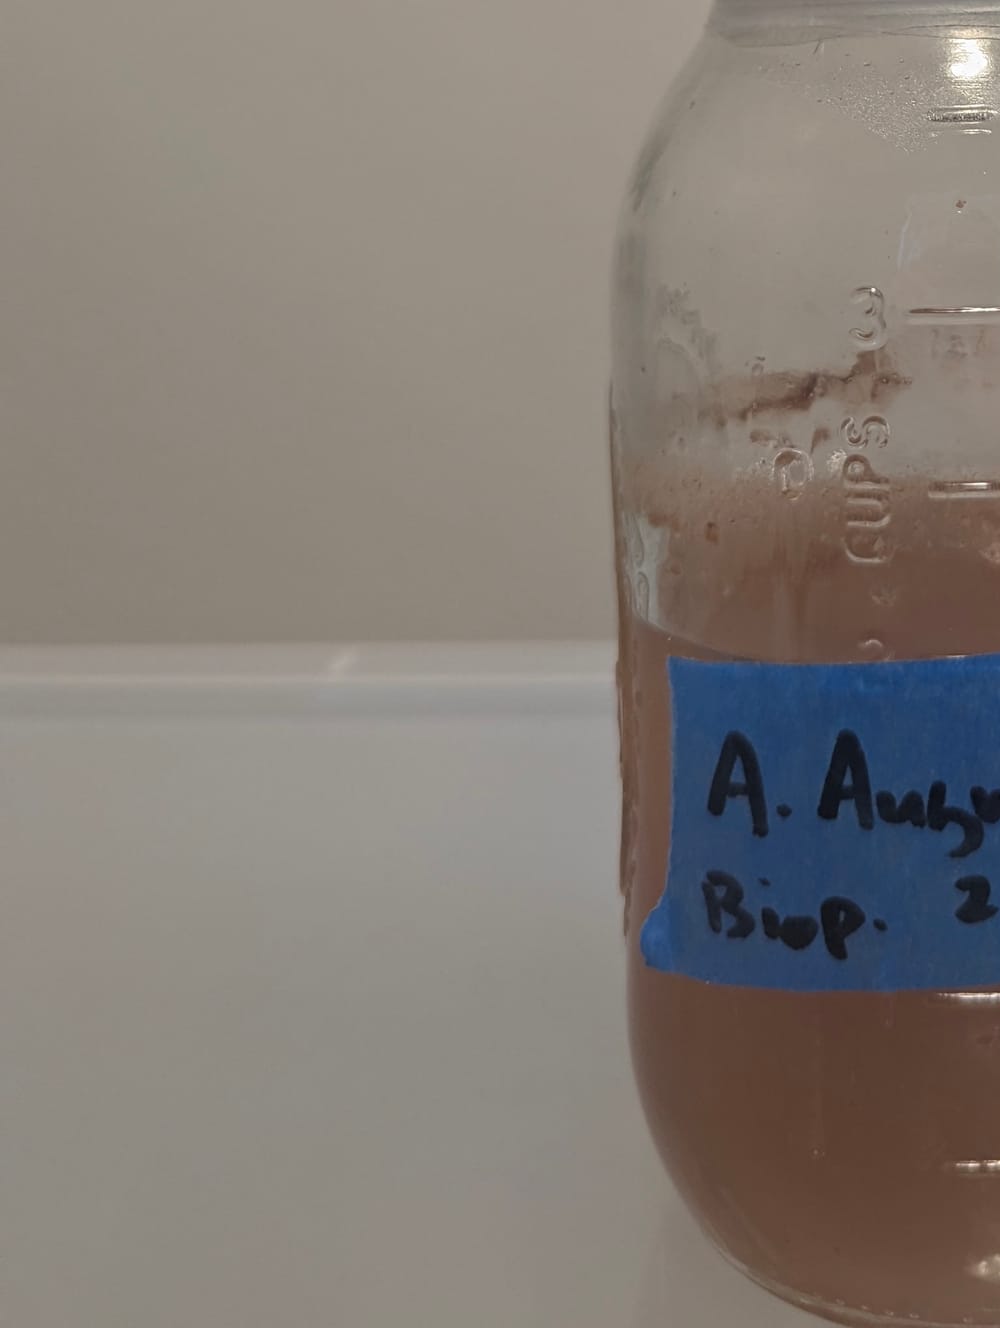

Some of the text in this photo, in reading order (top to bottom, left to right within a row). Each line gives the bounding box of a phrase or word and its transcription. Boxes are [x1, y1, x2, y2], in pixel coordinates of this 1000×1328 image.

[849, 285, 889, 352] 3
[841, 415, 893, 566] CUPS
[706, 730, 792, 838] A.
